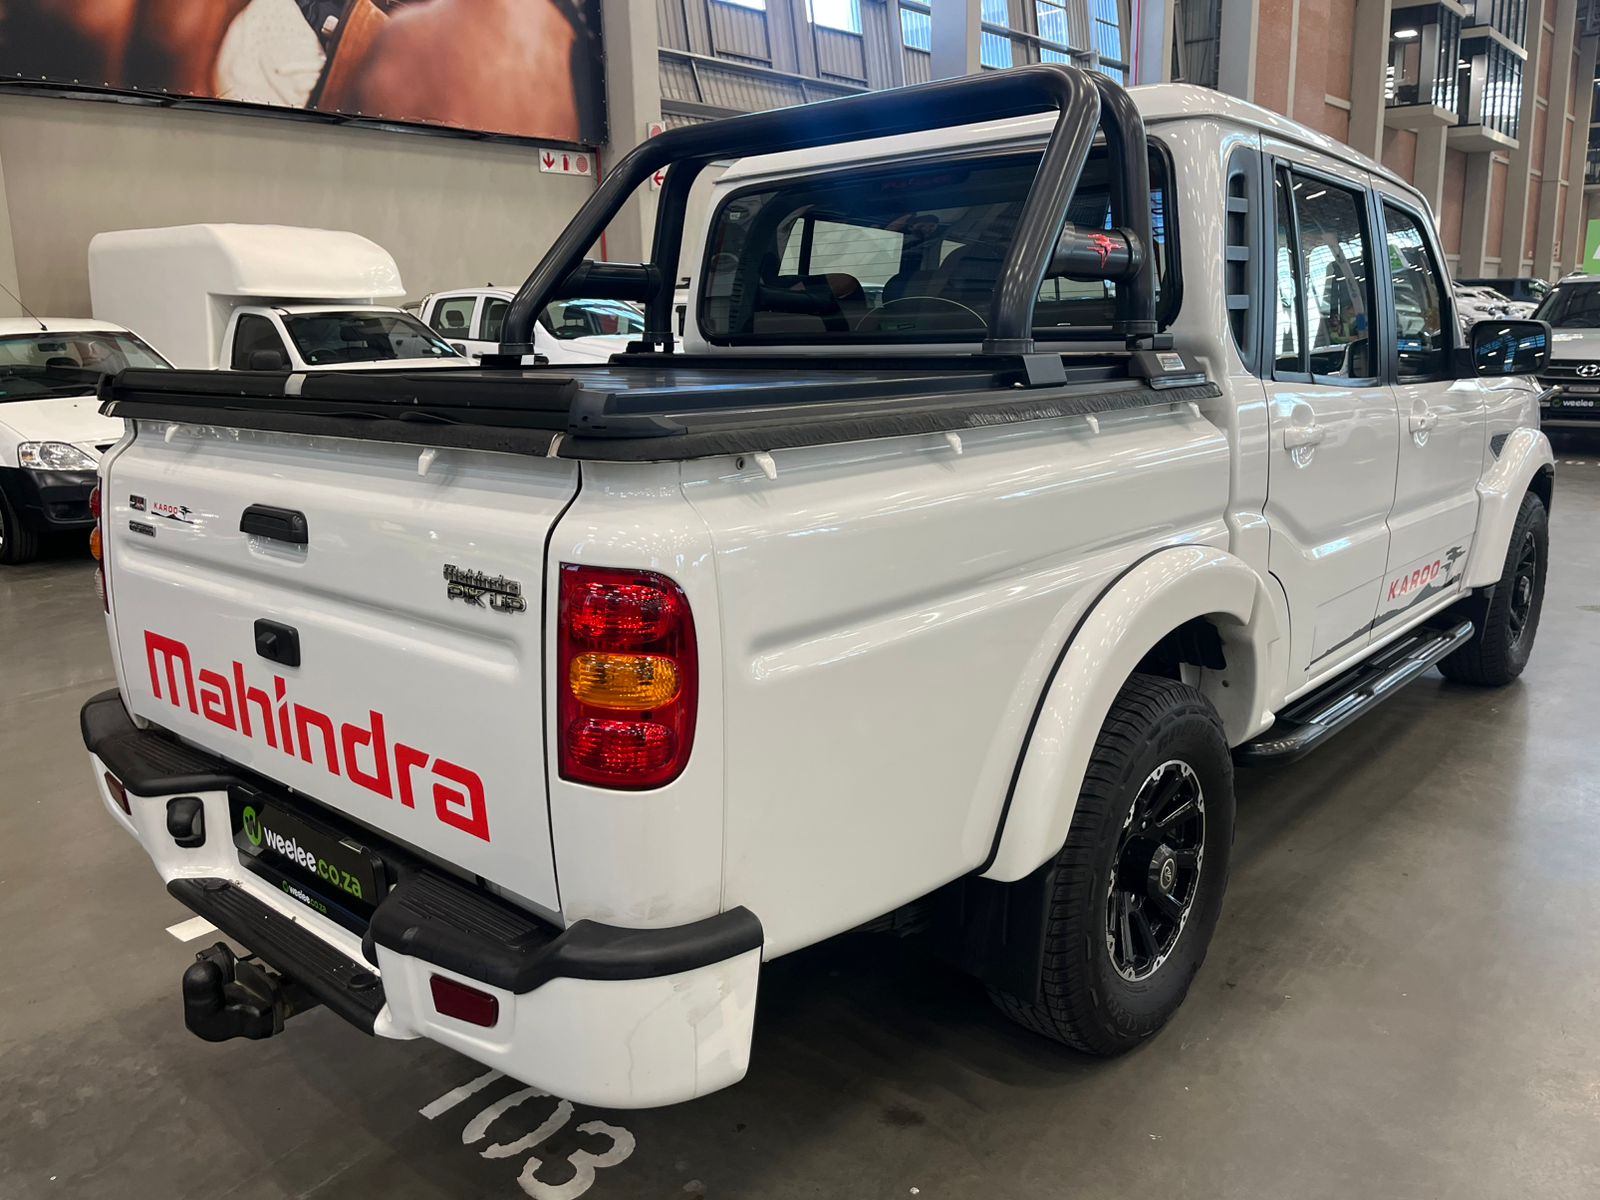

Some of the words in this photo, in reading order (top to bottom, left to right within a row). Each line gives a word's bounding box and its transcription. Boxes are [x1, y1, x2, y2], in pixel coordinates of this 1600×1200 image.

[153, 502, 179, 514] KAROO
[1386, 559, 1441, 602] KAROO
[263, 826, 363, 900] weelee.co.za
[418, 1068, 636, 1200] 103
